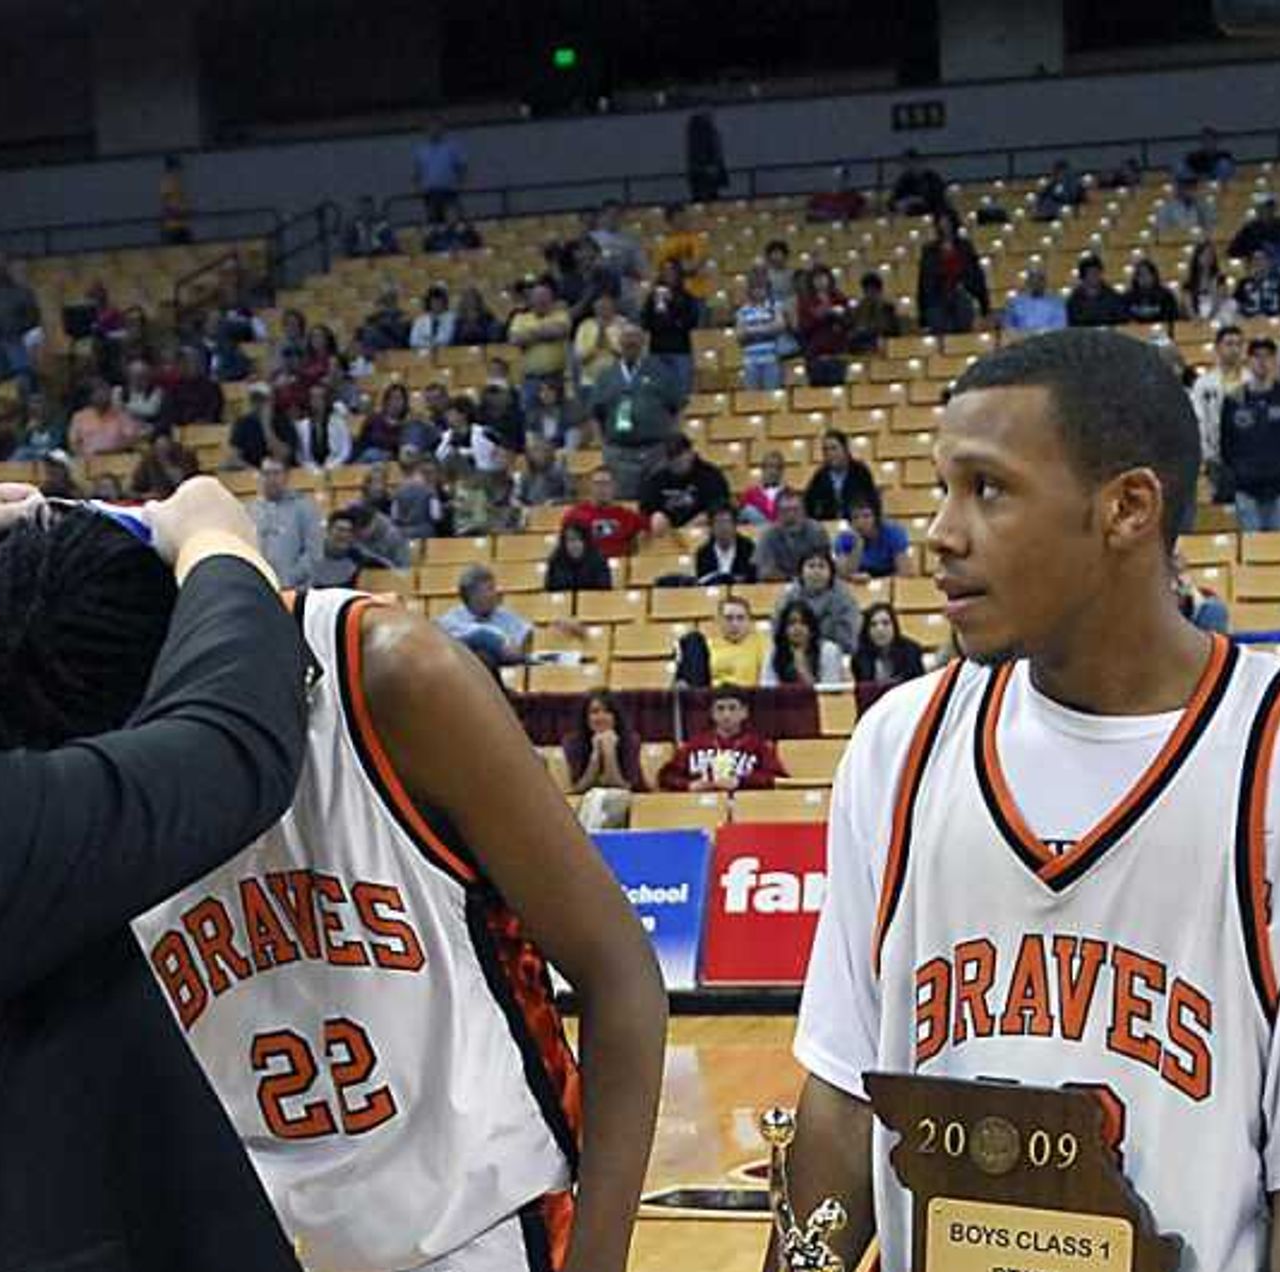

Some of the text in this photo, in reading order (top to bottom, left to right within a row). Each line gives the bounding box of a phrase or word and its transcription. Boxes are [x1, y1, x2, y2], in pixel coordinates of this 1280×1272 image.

[151, 869, 426, 1031] BRAVES
[251, 1017, 398, 1140] 22
[915, 933, 1213, 1102] BRAVES
[918, 1117, 1078, 1169] 20 09
[949, 1222, 1110, 1260] BOYS CLASS 1
